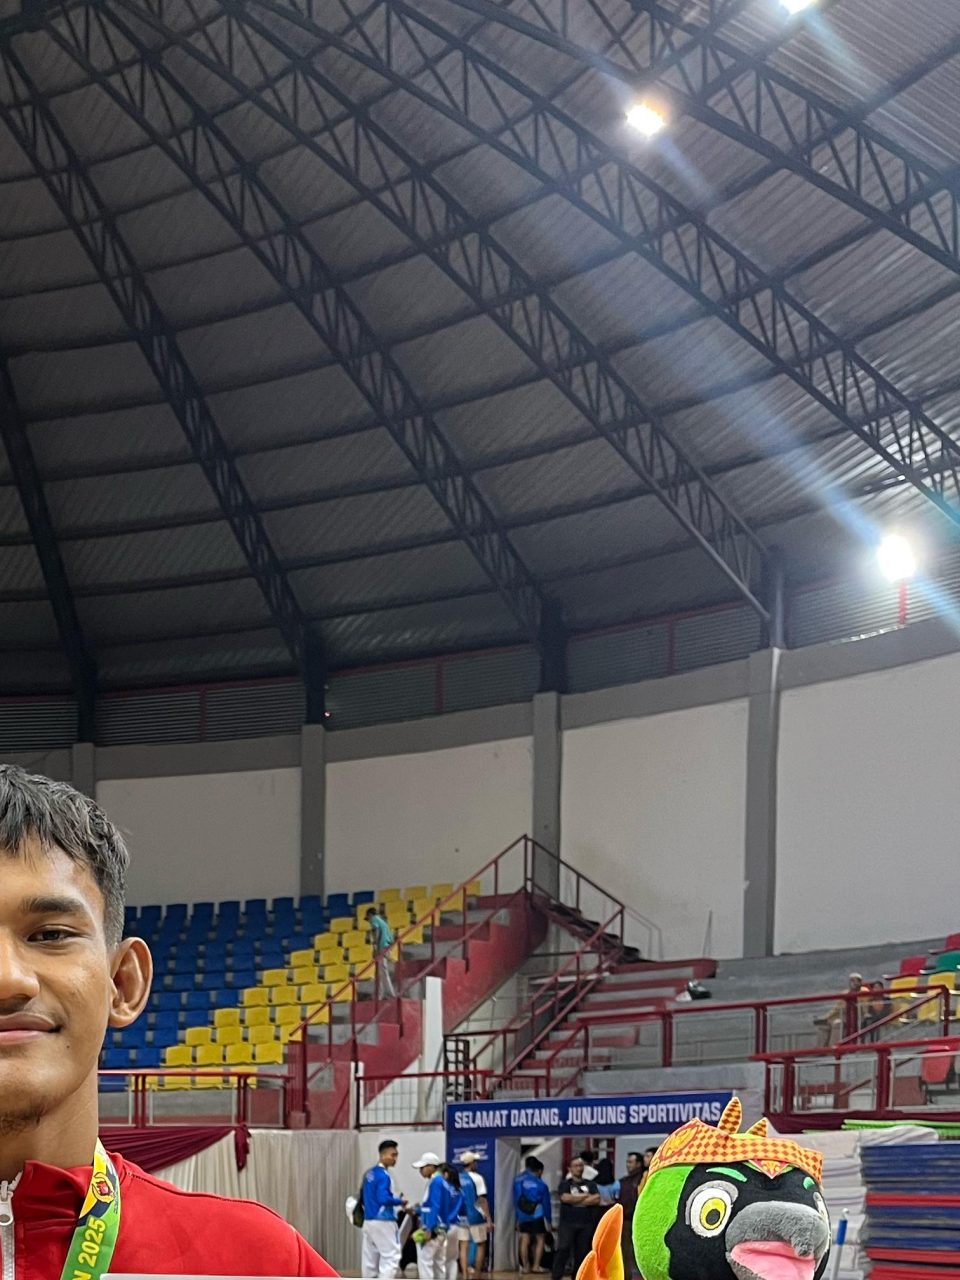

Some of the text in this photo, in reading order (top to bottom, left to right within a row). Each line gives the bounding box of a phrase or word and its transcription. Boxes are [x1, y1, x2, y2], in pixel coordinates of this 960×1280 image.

[454, 1101, 721, 1130] SELAMAT DATANG, JUNJUNG SPORTIVITAS
[78, 1216, 107, 1267] 2025
